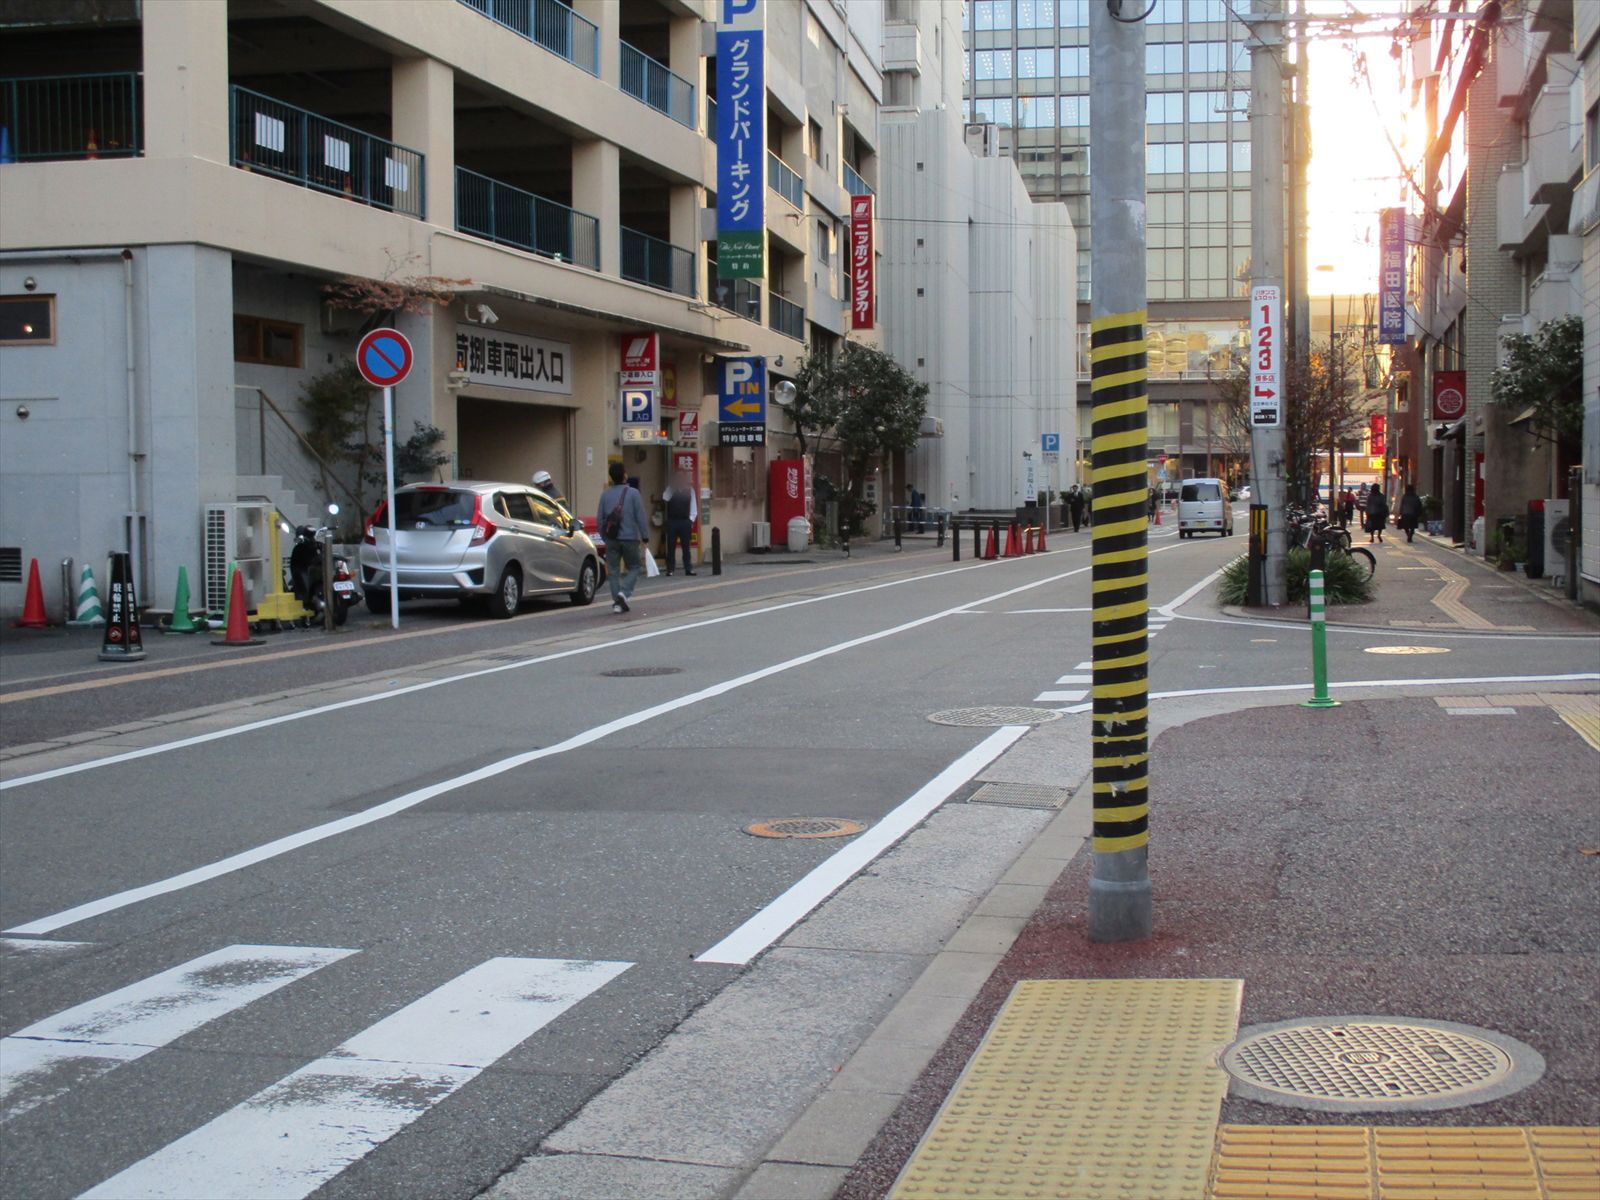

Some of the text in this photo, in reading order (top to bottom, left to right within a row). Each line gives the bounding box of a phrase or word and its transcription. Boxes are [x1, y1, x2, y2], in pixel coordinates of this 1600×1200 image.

[730, 38, 751, 221] グランドパーキング
[855, 224, 869, 322] ニッポンレンタカー
[1384, 251, 1402, 329] 福田医院
[726, 361, 753, 395] P
[740, 382, 760, 395] IN
[626, 392, 648, 421] P
[636, 413, 650, 421] 入口
[1046, 435, 1056, 450] P
